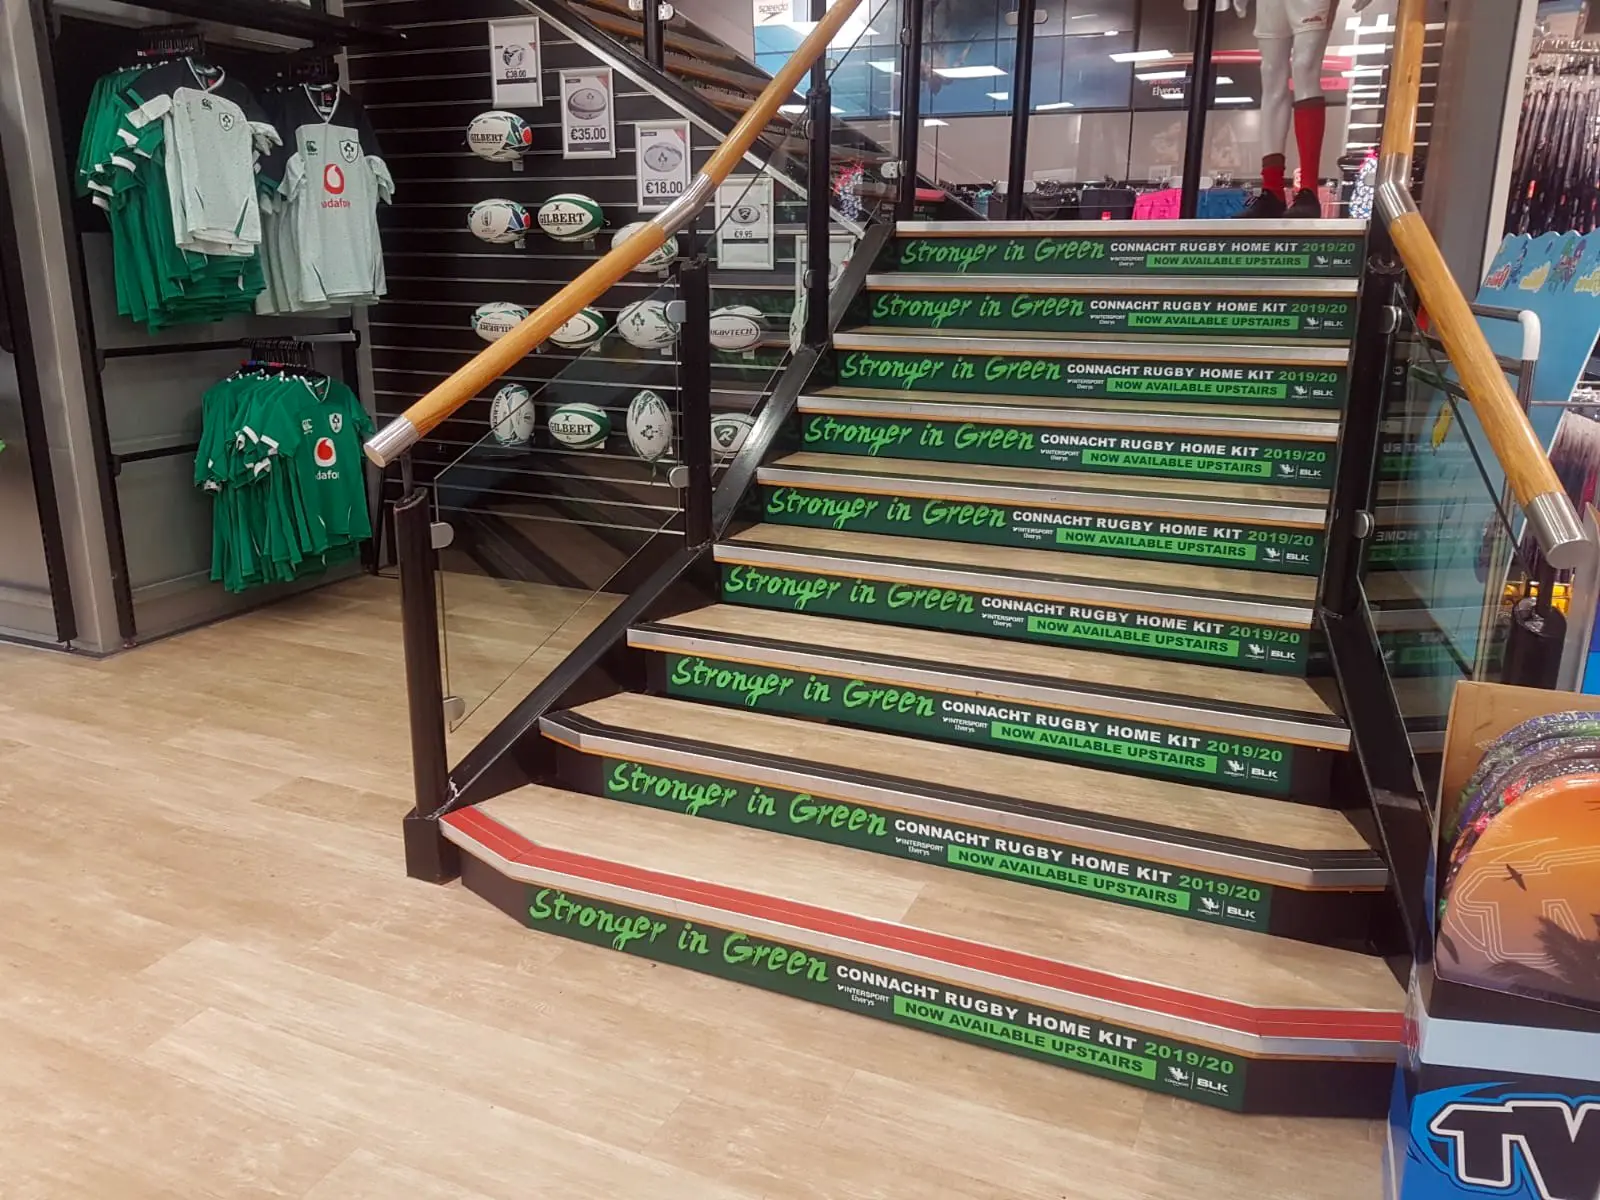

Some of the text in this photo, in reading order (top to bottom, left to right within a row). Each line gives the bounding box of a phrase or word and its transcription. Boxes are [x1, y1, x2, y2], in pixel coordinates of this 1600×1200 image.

[470, 133, 504, 143] GILBERT
[570, 127, 607, 141] €35.00
[645, 181, 683, 194] €18.00
[539, 212, 585, 225] GILBERT
[901, 237, 1105, 273] Stronger in Green
[1110, 242, 1356, 252] CONNACHT RUGBY HOME KIT 2019/20
[1153, 257, 1179, 265] NOW
[1181, 257, 1241, 265] AVAILABLE
[873, 293, 1084, 328] Stronger in Green
[1090, 299, 1348, 314] CONNACHT RUGBY HOME KIT 2019/20
[710, 327, 755, 337] UGBYTECH
[1135, 316, 1162, 324] NOW
[1164, 316, 1227, 325] AVAILABLE
[1232, 318, 1290, 327] UPSTAIRS
[841, 352, 1061, 389] Stronger in Green
[1067, 363, 1338, 383] CONNACHT RUGBY HOME KIT 2019/20
[1114, 381, 1277, 395] NOW AVAILABLE UPSTAIRS
[550, 421, 594, 434] GILBERT
[805, 415, 1034, 455] Stronger in Green
[1041, 433, 1327, 462] CONNACHT RUGBY HOME KIT 2019/20
[1090, 453, 1262, 473] NOW AVAILABLE UPSTAIRS
[768, 487, 1006, 529] Stronger in Green
[1012, 510, 1315, 546] CONNACHT RUGBY HOME KIT 2019/20
[1065, 532, 1246, 556] NOW AVAILABLE UPSTAIRS
[1286, 552, 1310, 560] BLK
[726, 565, 975, 613] Stronger in Green
[981, 596, 1301, 644] CONNACHT RUGBY HOME KIT 2019/20
[1037, 621, 1228, 652] NOW AVAILABLE UPSTAIRS
[1270, 649, 1296, 659] BLK
[671, 656, 935, 717] Stronger in Green
[942, 699, 1283, 762] CONNACHT RUGBY HOME KIT 2019/20
[1001, 727, 1205, 768] NOW AVAILABLE UPSTAIRS
[1251, 767, 1278, 778] BLK
[608, 762, 887, 836] Stronger in Green
[895, 819, 1261, 901] CONNACHT RUGBY HOME KIT 2019/20
[958, 851, 1177, 904] NOW AVAILABLE UPSTAIRS
[1227, 906, 1256, 918] BLK
[529, 888, 828, 982] Stronger in Green
[837, 965, 1234, 1074] CONNACHT RUGBY HOME KIT 2019/20
[905, 1003, 1142, 1072] NOW AVAILABLE UPSTAIRS
[1197, 1078, 1228, 1092] BLK
